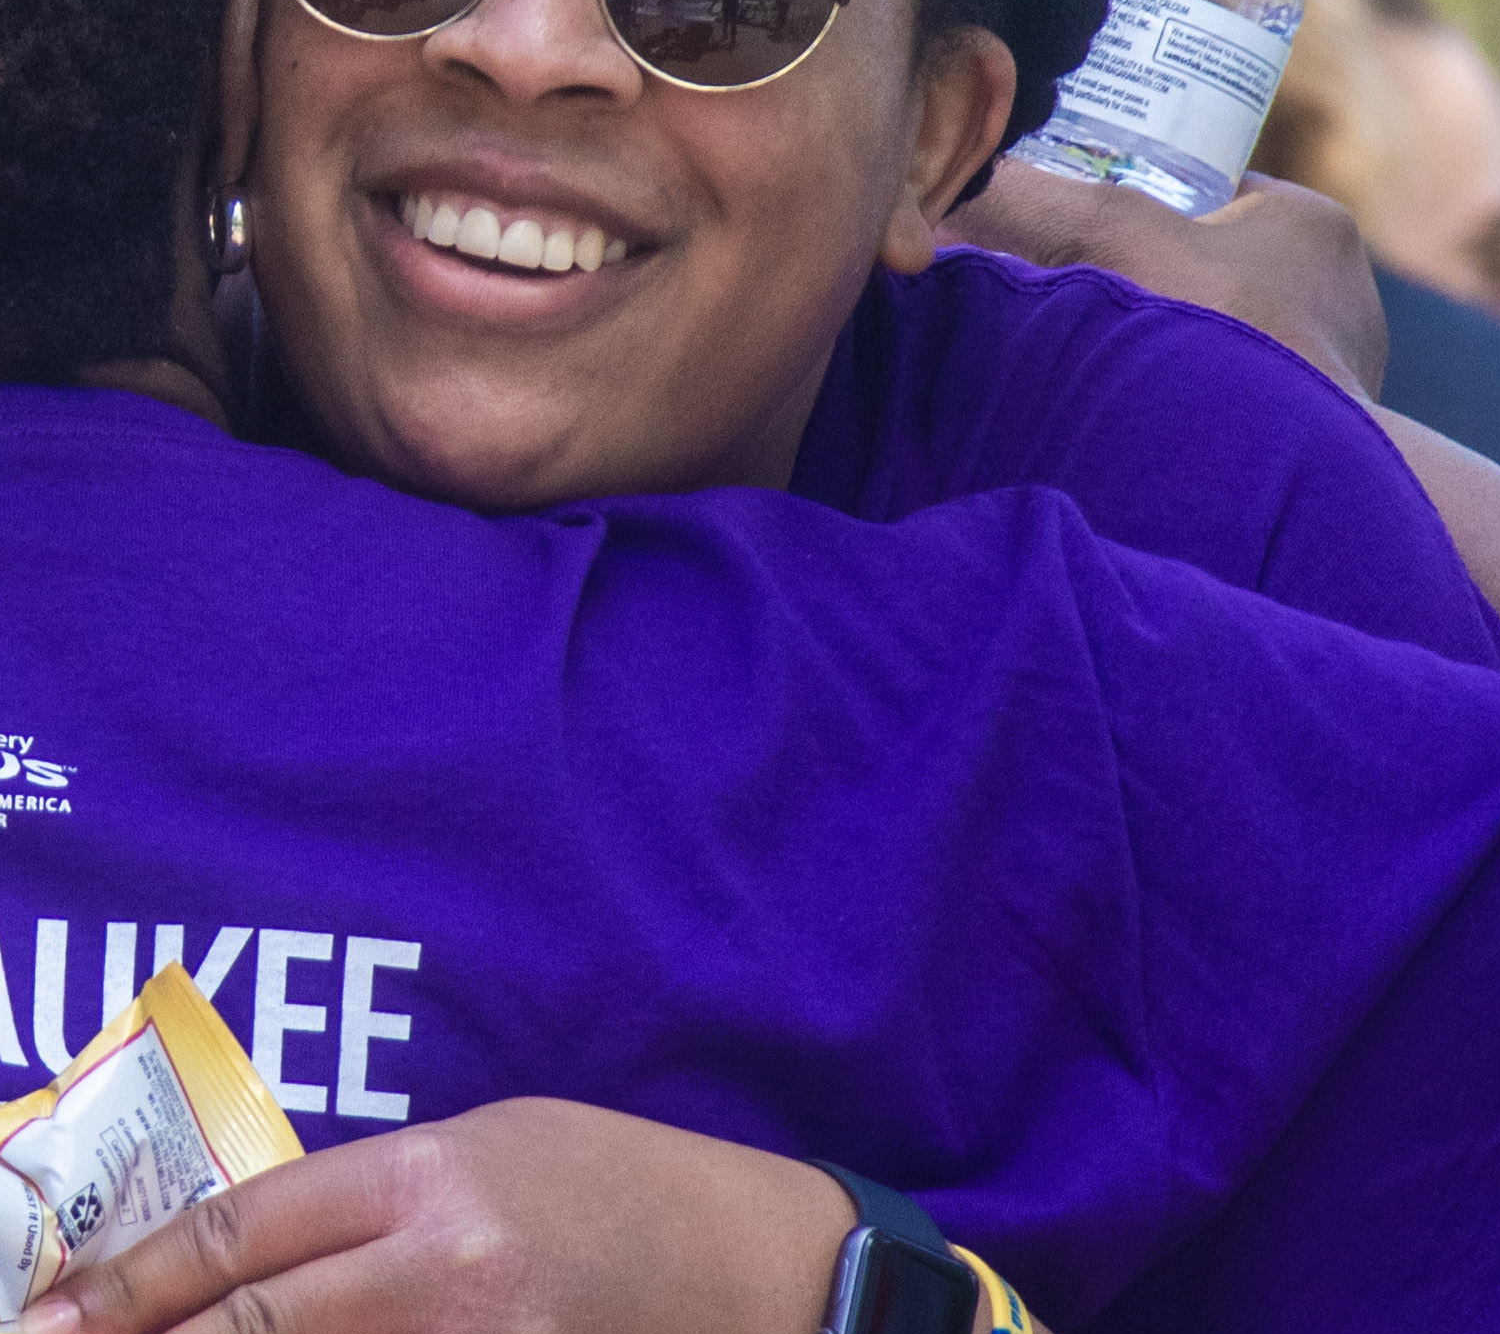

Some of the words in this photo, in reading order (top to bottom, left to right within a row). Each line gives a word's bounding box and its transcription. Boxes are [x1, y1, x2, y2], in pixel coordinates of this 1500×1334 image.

[27, 1211, 39, 1221] If
[23, 1222, 37, 1257] Used
[18, 1256, 30, 1272] By
